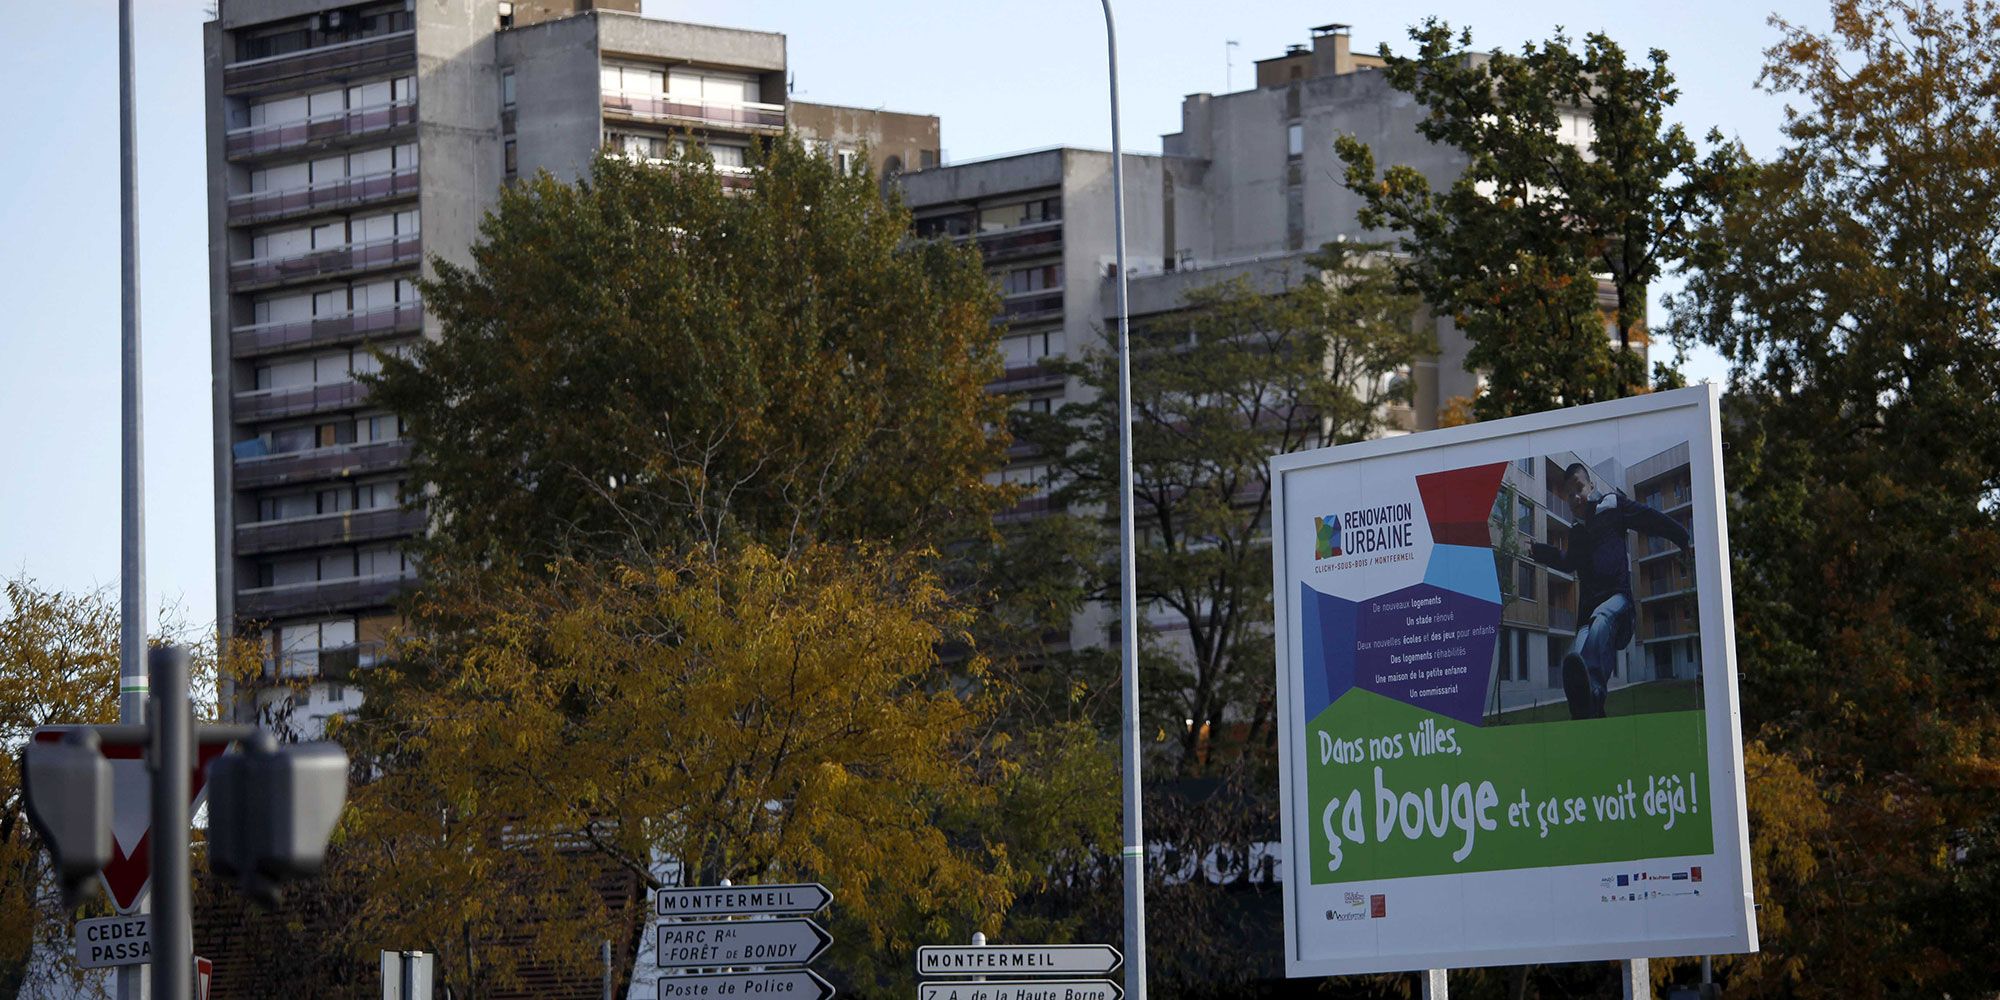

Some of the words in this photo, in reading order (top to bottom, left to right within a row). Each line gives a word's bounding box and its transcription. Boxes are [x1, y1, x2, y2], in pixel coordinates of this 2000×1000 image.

[1344, 503, 1411, 529] RENOVATION
[1345, 523, 1413, 555] URBAINE
[1315, 560, 1368, 573] CLICHY-SOUS-BOIS
[1374, 553, 1414, 564] MONTFERMEIL
[1373, 602, 1380, 613] De
[1382, 600, 1410, 612] nouveaux
[1411, 595, 1442, 609] logements
[1406, 616, 1415, 626] Un
[1416, 614, 1432, 625] stade
[1433, 611, 1454, 622] rénové
[1357, 640, 1371, 651] Deux
[1373, 636, 1401, 649] nouvelles
[1402, 634, 1422, 645] écoles
[1423, 634, 1430, 642] et
[1431, 631, 1442, 641] des
[1442, 630, 1455, 642] jeux
[1456, 630, 1470, 641] pour
[1472, 625, 1495, 636] enfants
[1390, 654, 1401, 664] Des
[1402, 651, 1433, 664] logements
[1433, 646, 1467, 659] réhabilités
[1375, 674, 1387, 684] Une
[1388, 671, 1408, 682] maison
[1410, 669, 1418, 680] de
[1418, 668, 1425, 679] la
[1426, 667, 1443, 680] petite
[1444, 664, 1468, 676] enfance
[1409, 688, 1418, 698] Un
[1419, 684, 1459, 697] commissariat
[1318, 730, 1365, 766] Dans
[1369, 734, 1404, 761] nos
[1409, 718, 1462, 756] villes,
[1322, 788, 1365, 872] ça
[1374, 766, 1499, 863] bouge
[1508, 788, 1530, 828] et
[1537, 797, 1560, 839] ça
[1564, 797, 1587, 825] se
[1592, 778, 1637, 822] voit
[1643, 774, 1687, 831] déjà
[664, 892, 795, 909] MONTFERMEIL
[87, 921, 147, 942] CEDEZ
[664, 930, 706, 944] PARC
[92, 941, 151, 961] PASSA
[726, 950, 738, 959] DE
[744, 943, 797, 959] BONDY
[927, 953, 1054, 967] MONTFERMEIL
[665, 983, 708, 997] Poste
[718, 981, 736, 995] de
[744, 980, 794, 993] Police
[971, 990, 988, 1000] de
[995, 989, 1008, 1000] la
[1016, 989, 1057, 1000] Haute
[1065, 988, 1105, 1000] Borne
